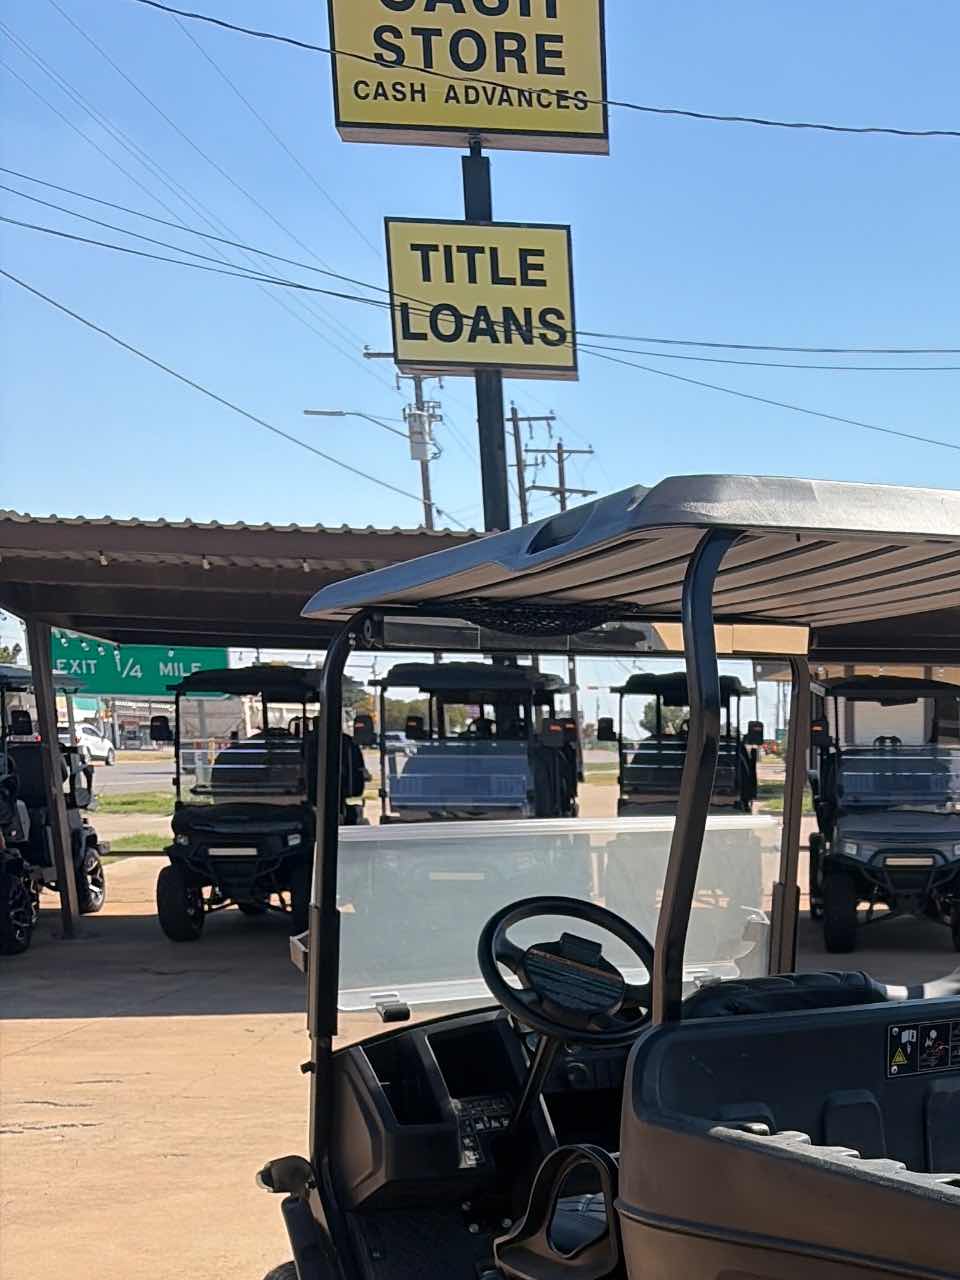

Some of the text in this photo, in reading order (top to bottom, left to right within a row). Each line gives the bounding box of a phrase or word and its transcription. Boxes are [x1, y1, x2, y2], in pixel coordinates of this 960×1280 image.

[373, 25, 566, 76] STORE
[353, 79, 589, 111] CASH ADVANCES
[410, 243, 547, 287] TITLE
[399, 301, 567, 347] LOANS
[56, 659, 97, 674] EXIT
